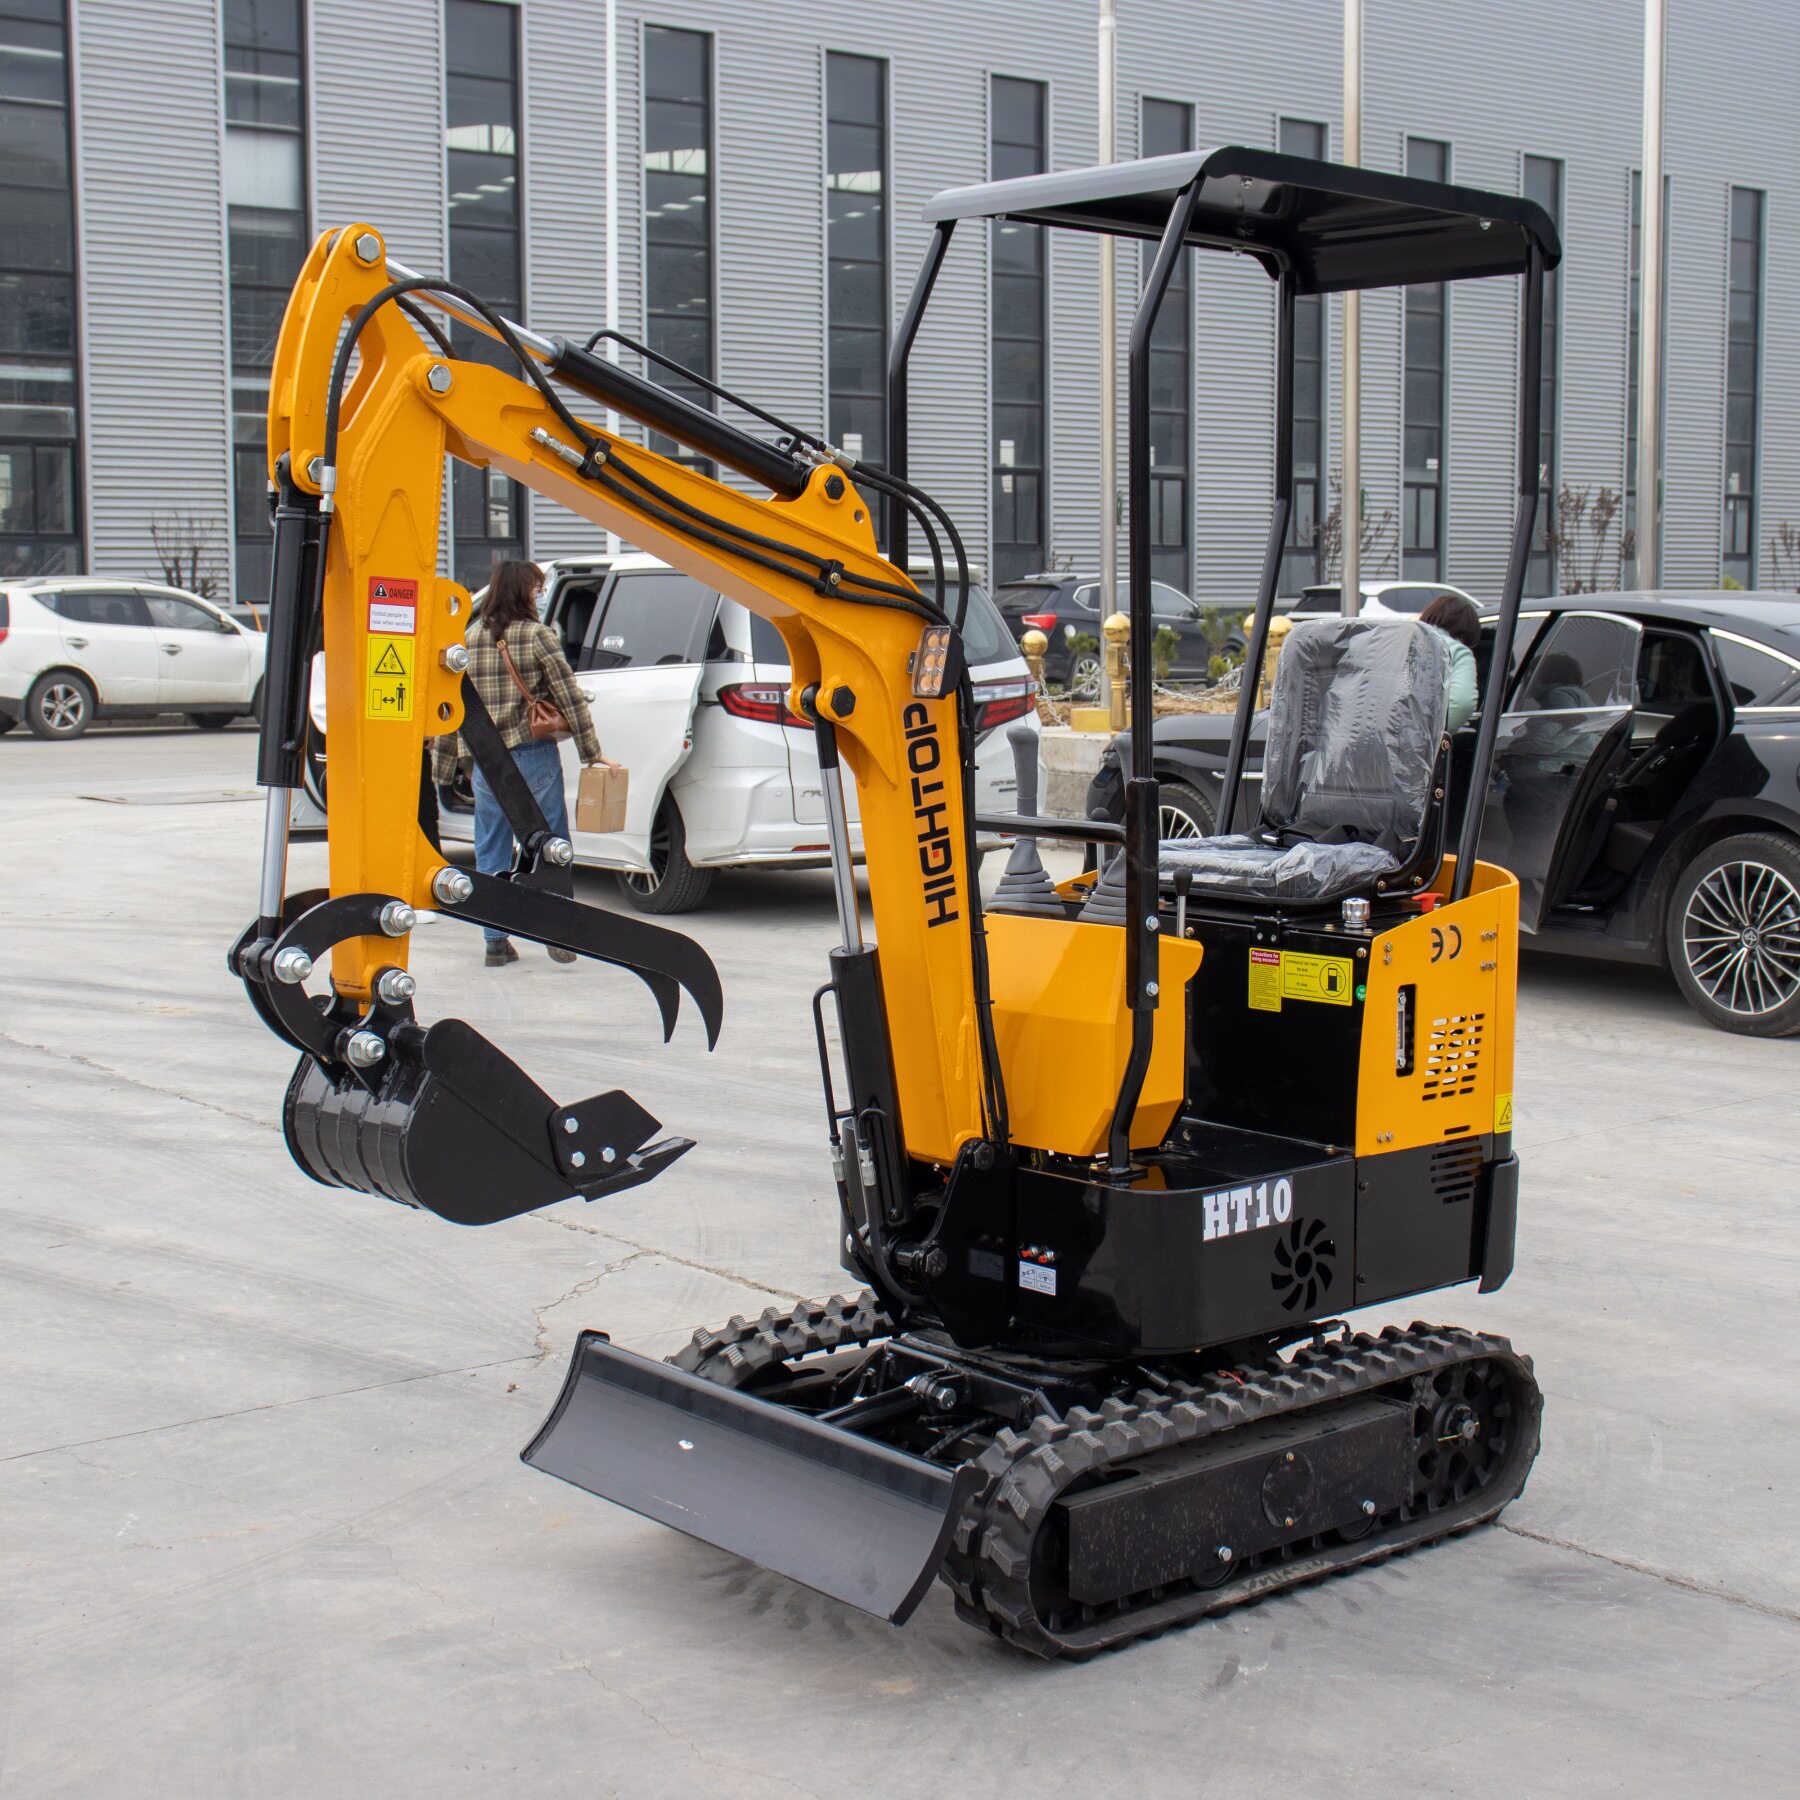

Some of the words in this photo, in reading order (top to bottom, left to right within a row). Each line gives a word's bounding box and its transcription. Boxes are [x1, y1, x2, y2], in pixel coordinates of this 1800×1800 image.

[389, 588, 414, 600] DANGER
[395, 621, 414, 629] working
[903, 702, 960, 929] HIGHTOP
[1203, 1178, 1292, 1241] HT10
